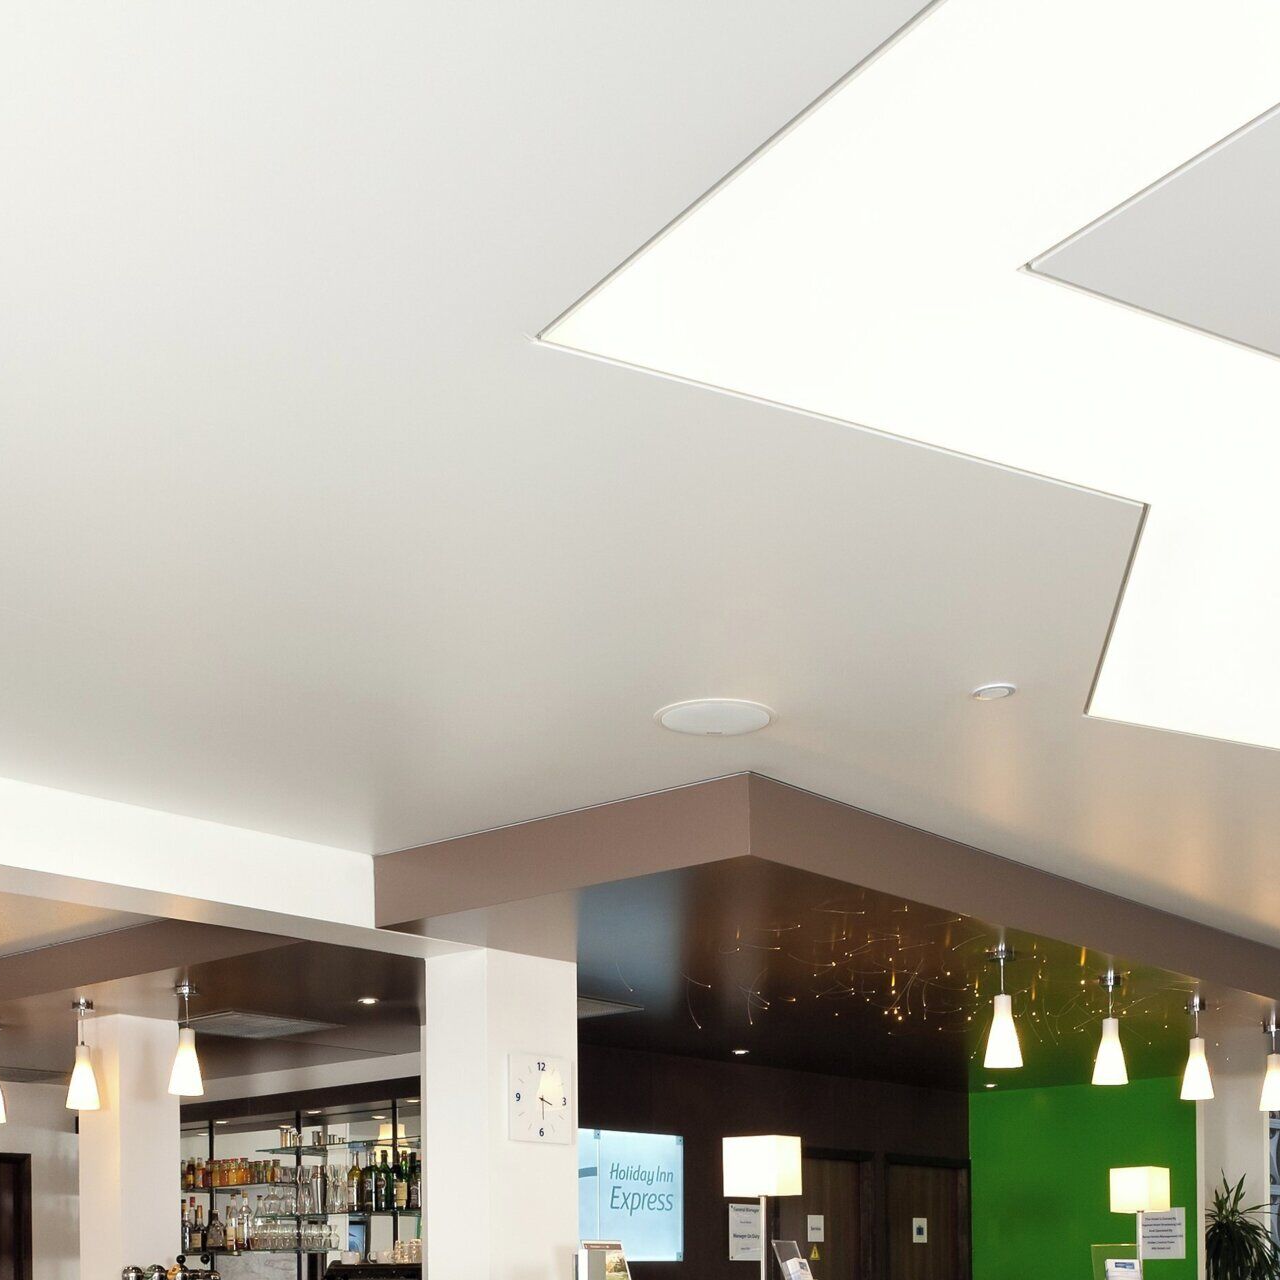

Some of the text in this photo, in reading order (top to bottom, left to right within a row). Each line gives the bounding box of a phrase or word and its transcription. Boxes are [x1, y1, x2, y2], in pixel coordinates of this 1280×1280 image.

[536, 1062, 546, 1072] 12
[515, 1092, 521, 1102] 9
[561, 1097, 567, 1106] 3
[539, 1128, 545, 1137] 6
[609, 1163, 674, 1186] Holiday Inn
[610, 1186, 674, 1216] Express
